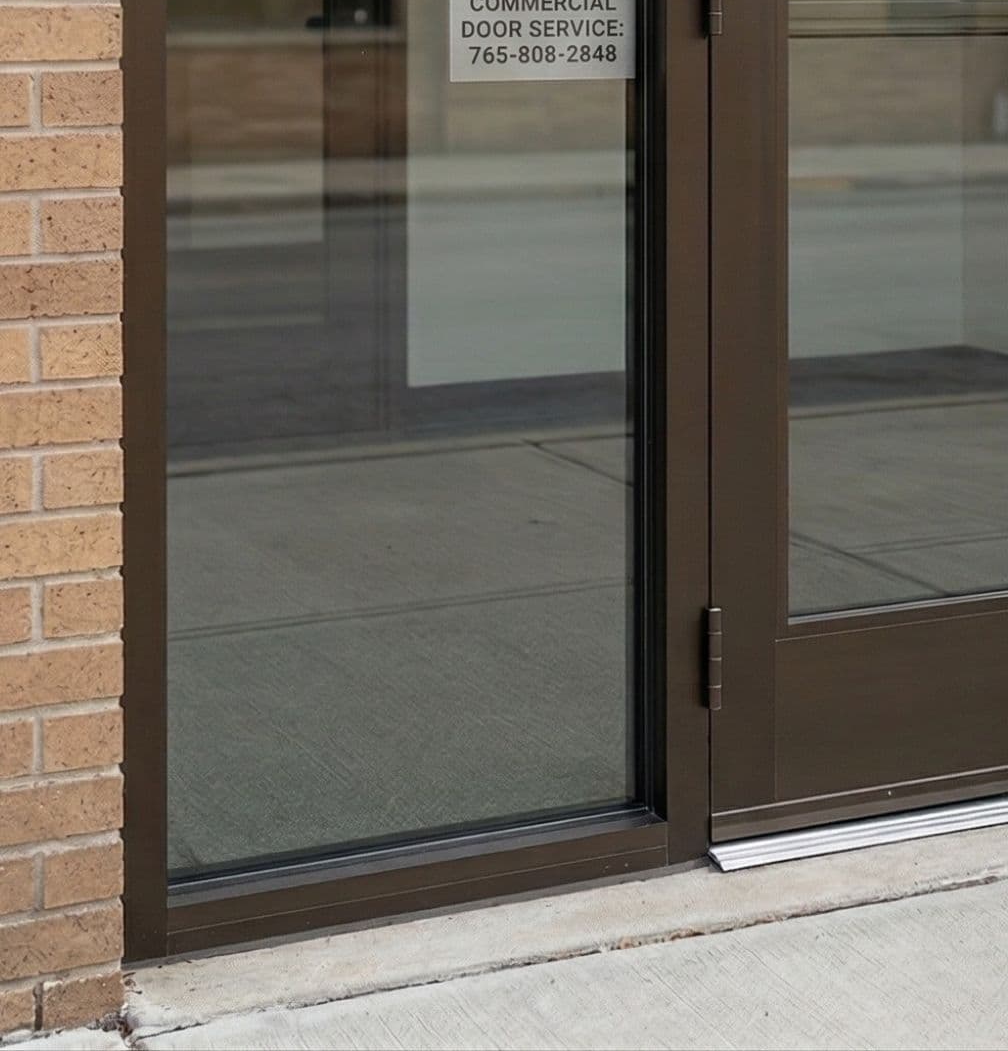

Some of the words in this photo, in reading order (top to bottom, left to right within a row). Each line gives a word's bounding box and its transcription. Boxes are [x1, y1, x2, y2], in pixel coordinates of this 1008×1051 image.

[462, 20, 522, 38] DOOR
[529, 19, 625, 38] SERVICE:
[468, 44, 617, 64] 765-808-2848
